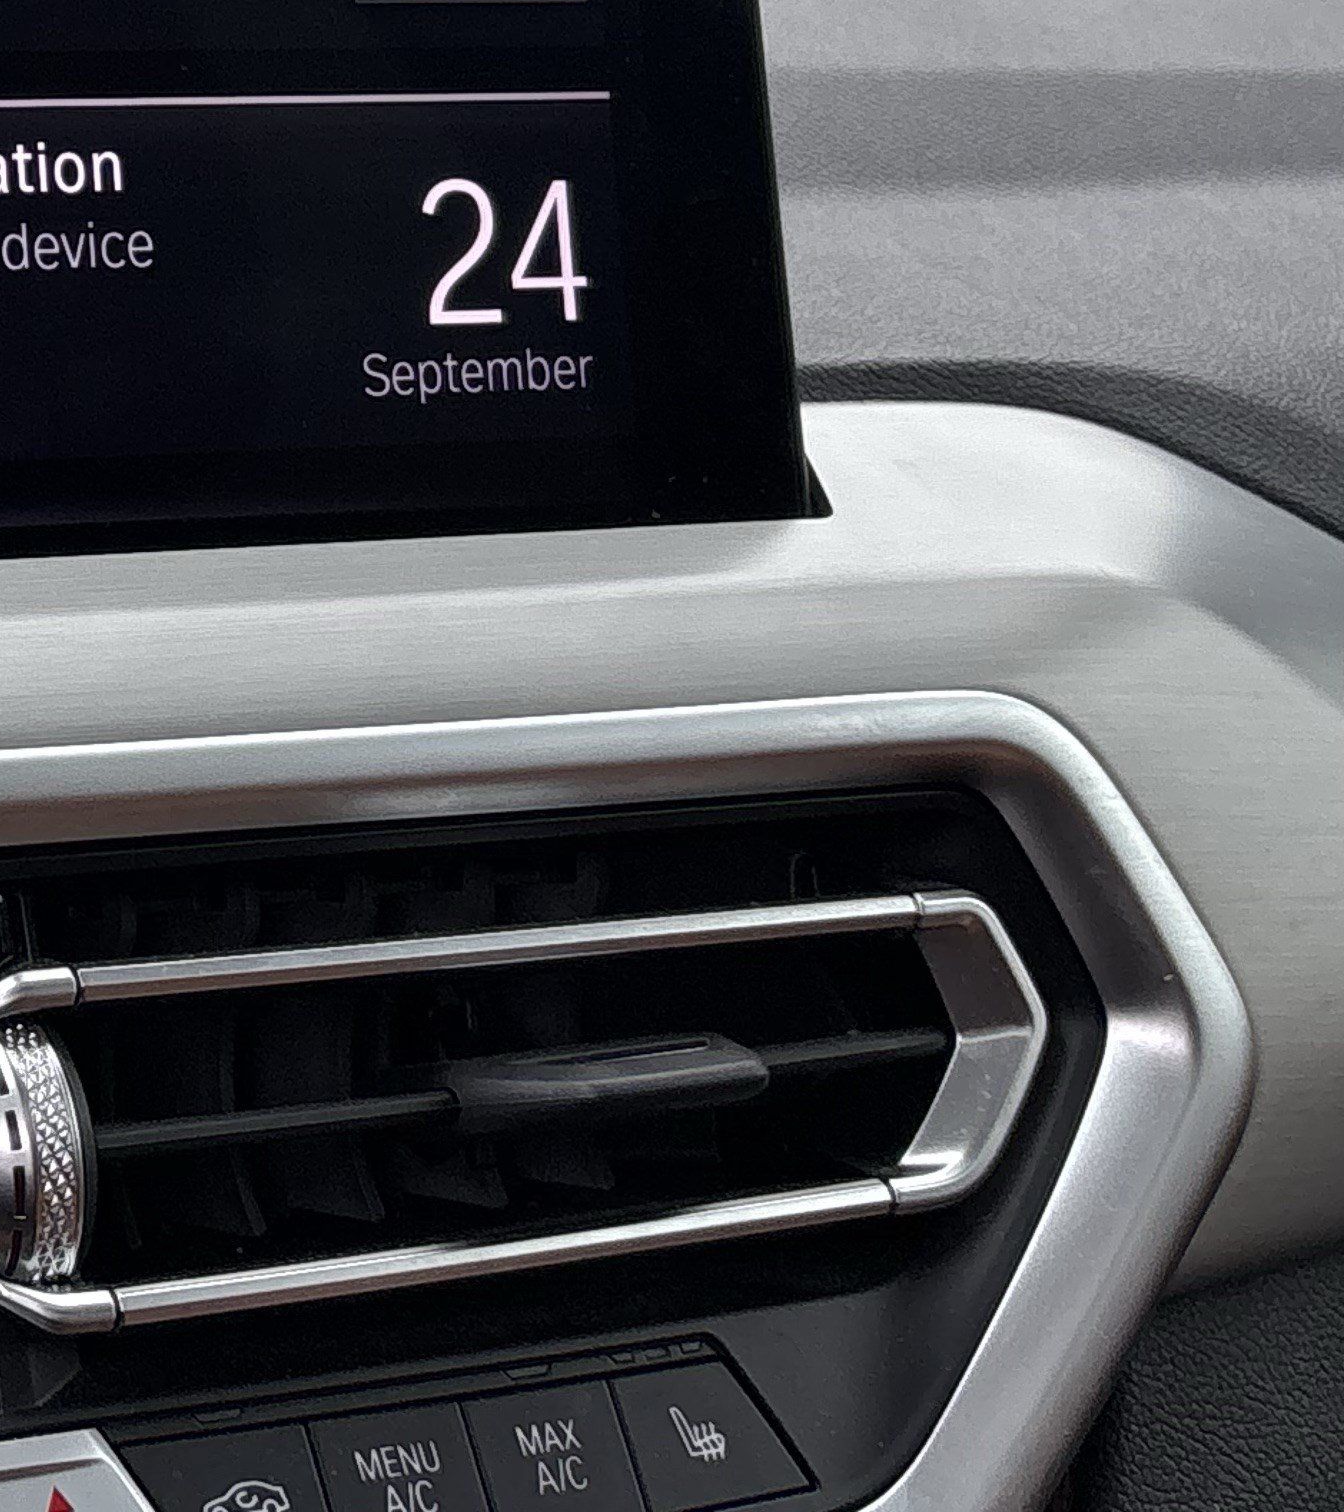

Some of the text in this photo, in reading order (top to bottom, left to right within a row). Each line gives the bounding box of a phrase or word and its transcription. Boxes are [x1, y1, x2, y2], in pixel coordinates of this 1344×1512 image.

[2, 222, 154, 271] device
[421, 178, 587, 325] 24
[362, 348, 594, 404] September
[515, 1420, 583, 1458] MAX
[354, 1441, 441, 1482] MENU
[537, 1455, 589, 1496] A/C
[385, 1479, 439, 1512] A/C
